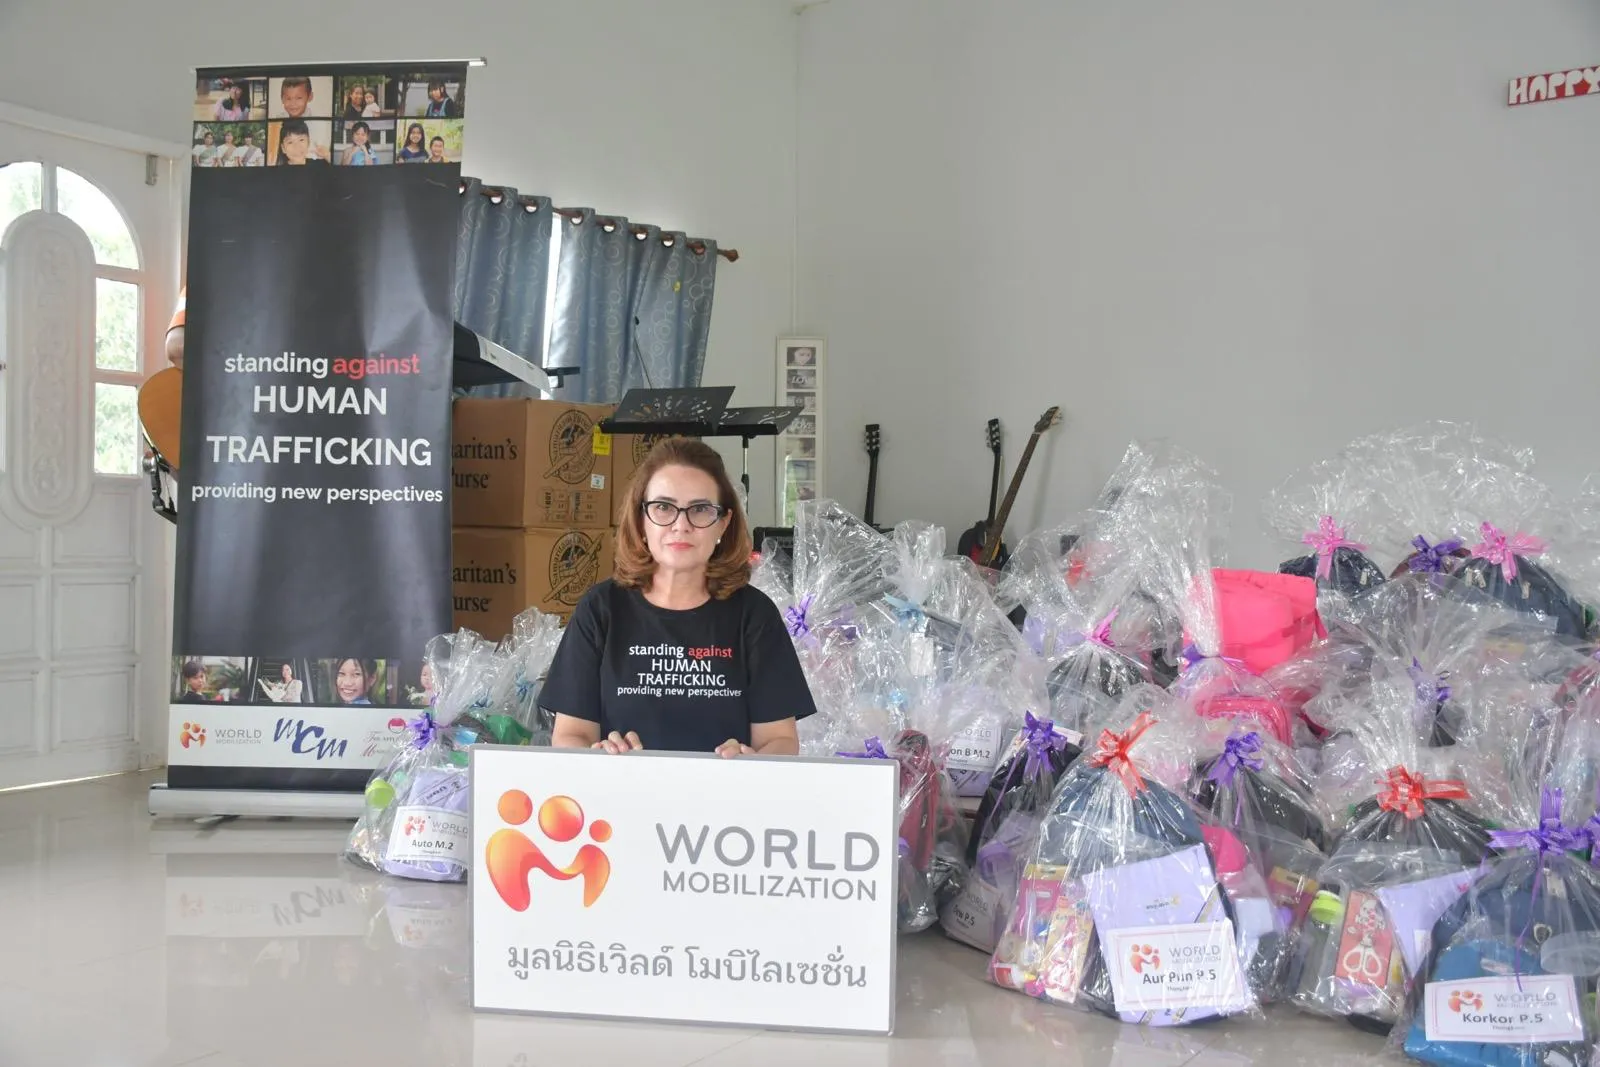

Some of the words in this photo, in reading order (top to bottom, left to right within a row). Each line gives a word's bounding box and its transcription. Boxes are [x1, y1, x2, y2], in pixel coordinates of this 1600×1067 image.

[1508, 66, 1600, 105] HAPPY
[224, 352, 328, 378] standing
[332, 354, 420, 379] against
[253, 385, 387, 415] HUMAN
[206, 435, 432, 466] TRAFFICKING
[452, 436, 517, 460] aritan's
[452, 467, 489, 488] urse
[191, 483, 277, 503] providing
[281, 486, 322, 500] new
[326, 487, 443, 504] perspectives
[629, 643, 684, 658] standing
[688, 645, 733, 659] against
[651, 659, 711, 672] HUMAN
[637, 673, 726, 686] TRAFFICKING
[617, 686, 662, 697] providing
[688, 688, 742, 698] perspectives
[215, 729, 262, 739] WORLD
[412, 840, 432, 848] Auto
[435, 840, 454, 850] M.2
[655, 822, 880, 872] WORLD
[663, 870, 877, 901] MOBILIZATION
[1169, 945, 1220, 957] WORLD
[508, 940, 674, 980] มูลนิธิเวิลด์
[684, 945, 867, 988] โมบิไลเซชั่น
[1143, 973, 1166, 984] Aur
[1494, 991, 1556, 1002] WORLD
[1463, 1013, 1514, 1024] Korkor
[1520, 1013, 1543, 1023] P.5
